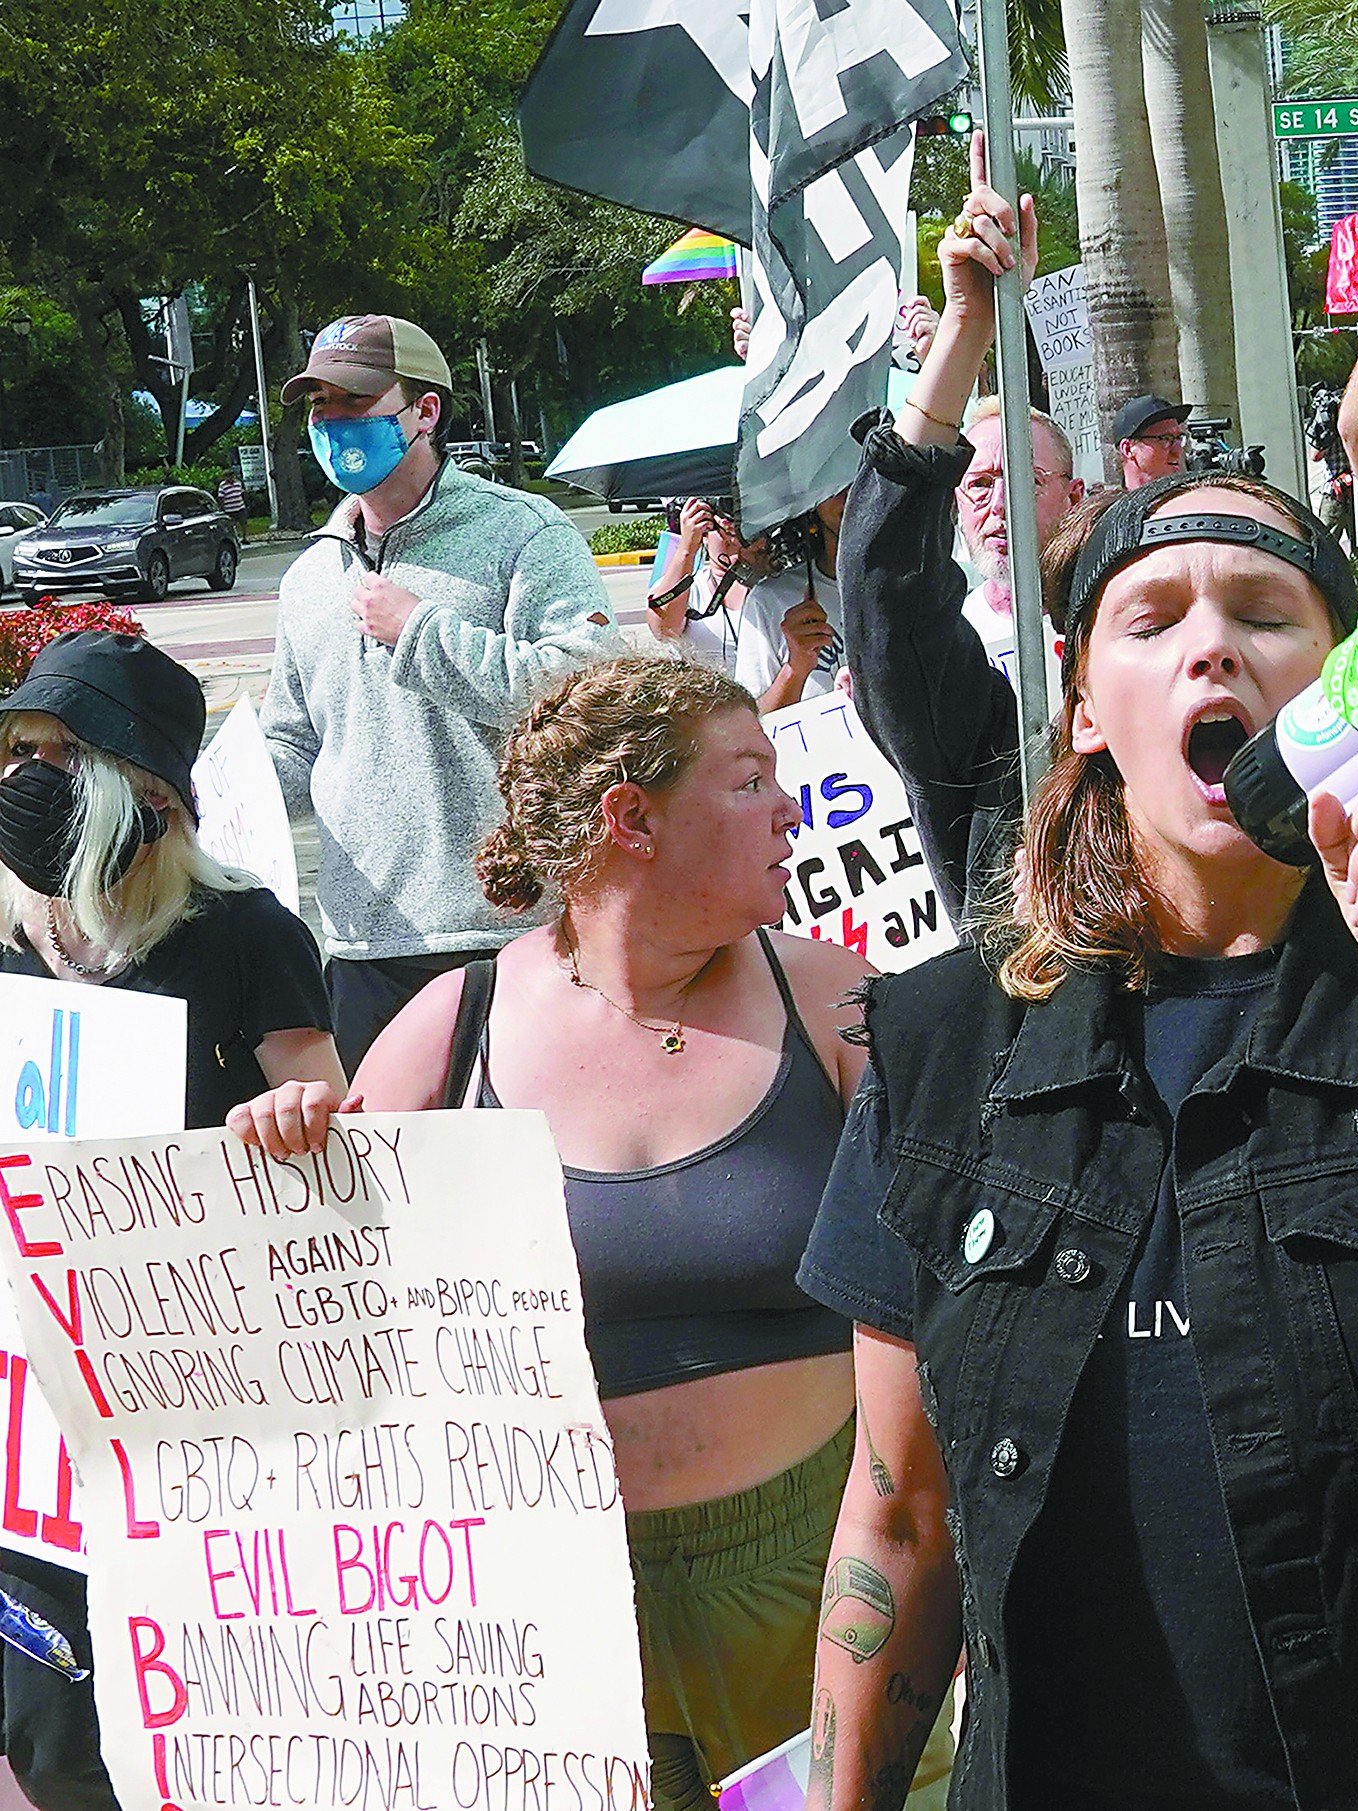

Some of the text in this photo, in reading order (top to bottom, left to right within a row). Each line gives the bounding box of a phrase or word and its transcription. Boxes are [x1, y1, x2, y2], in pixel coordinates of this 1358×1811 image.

[1279, 111, 1305, 129] SE
[1314, 107, 1339, 129] 14
[1045, 308, 1078, 334] NOT
[1050, 365, 1093, 386] EDUCAT
[1054, 393, 1096, 417] ATTAC
[769, 816, 925, 932] GAI
[15, 1007, 82, 1138] all
[0, 1126, 411, 1258] ERASING HISTORY
[31, 1225, 394, 1347] VIOLENCE AGAINST
[407, 1286, 435, 1310] AND
[435, 1277, 509, 1318] BIPOC
[512, 1289, 573, 1312] PEOPLE
[1128, 1300, 1191, 1338] LIV
[75, 1325, 564, 1418] IGNORING CLIMATE CHANGE
[292, 1422, 425, 1512] RIGHTS
[444, 1420, 620, 1516] REVOKED
[203, 1516, 487, 1620] EVIL BIGOT
[128, 1615, 548, 1729] BANNING LIFE SAVING
[356, 1681, 539, 1729] ABORTIONS
[152, 1731, 655, 1811] INTERSECTIONAL OPPRESSION
